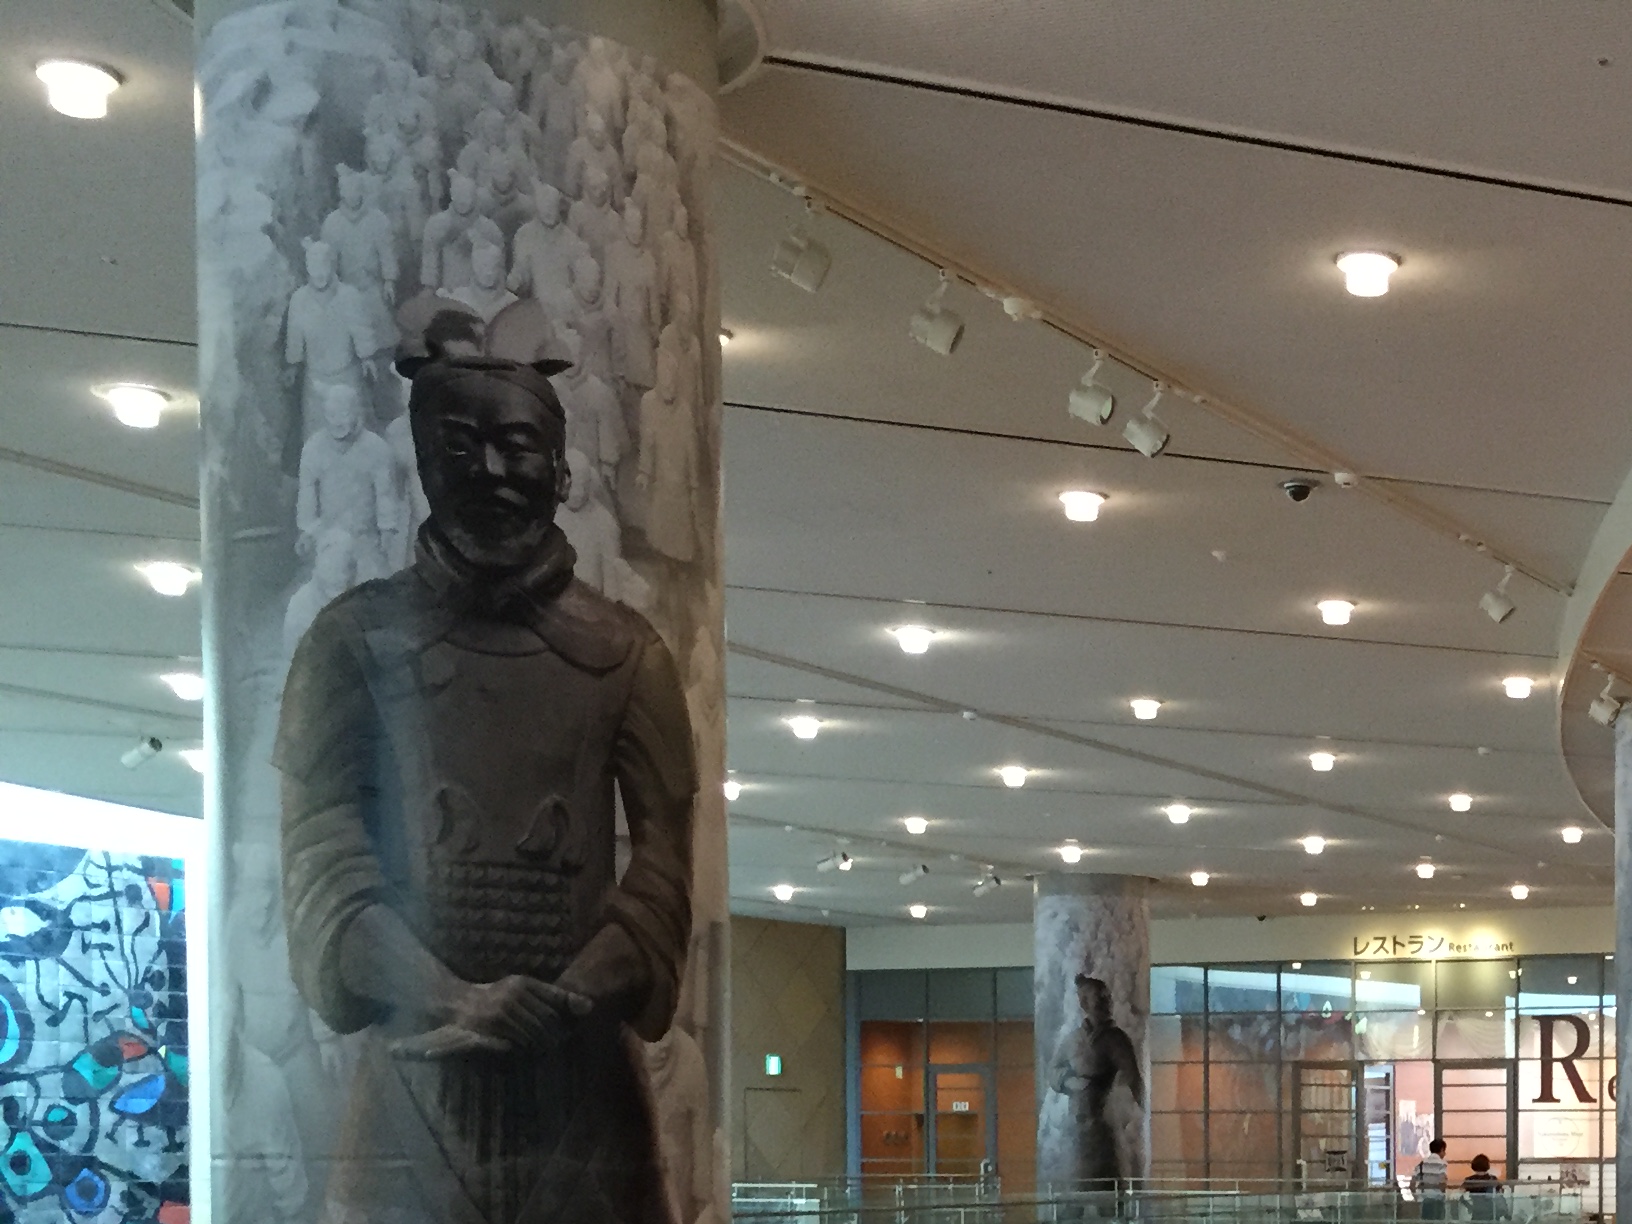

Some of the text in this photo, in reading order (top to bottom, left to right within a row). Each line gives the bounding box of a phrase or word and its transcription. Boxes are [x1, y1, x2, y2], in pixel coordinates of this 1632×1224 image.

[1353, 935, 1444, 956] レストラン
[1448, 941, 1515, 954] Resaant
